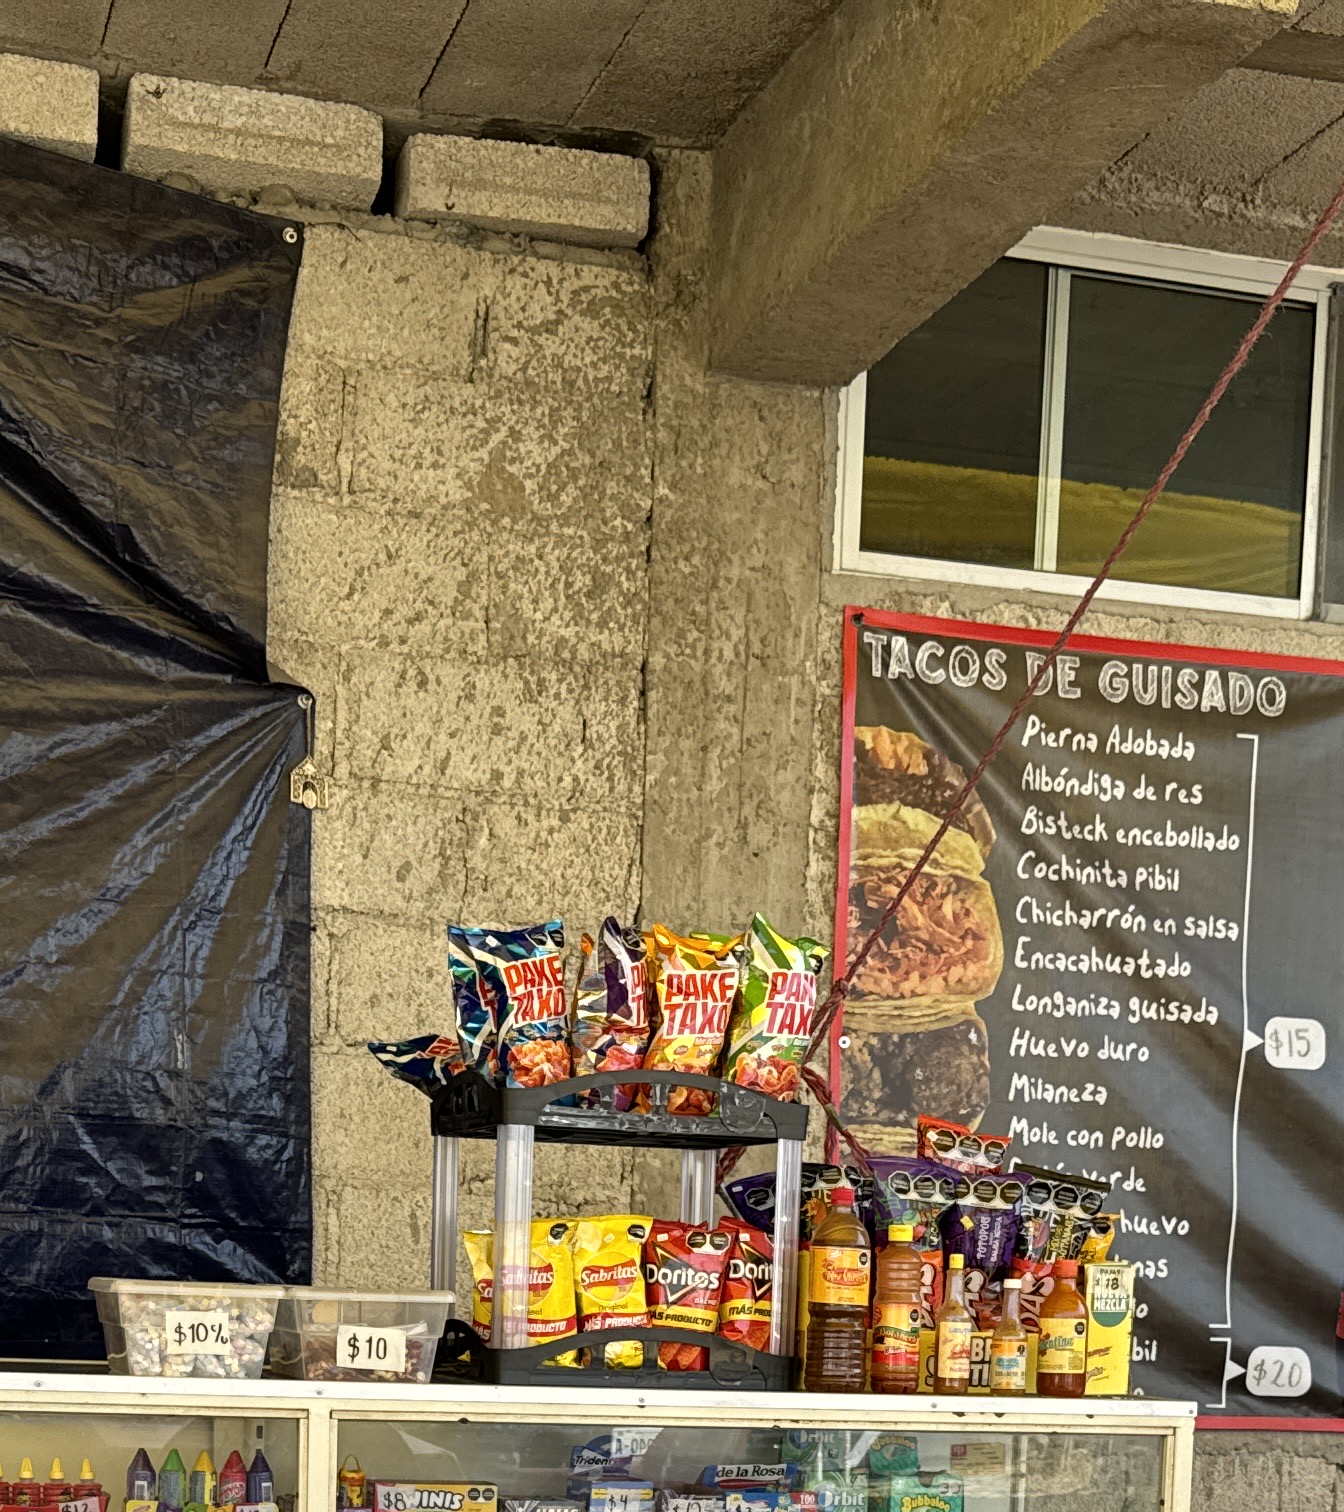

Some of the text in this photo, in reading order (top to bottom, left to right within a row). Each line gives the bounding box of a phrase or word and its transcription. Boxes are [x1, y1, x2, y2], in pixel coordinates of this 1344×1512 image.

[863, 633, 1287, 717] TACOS DE GUISADO
[1021, 715, 1196, 761] Pierna Adobada
[1021, 764, 1203, 805] Albóndiga de res
[1020, 807, 1240, 852] Bisteck encebollado
[1015, 897, 1239, 942] Chicharrón en salsa
[1014, 937, 1192, 979] Encacahuatado
[504, 955, 562, 994] PAKE
[665, 972, 738, 1002] PAKE
[511, 987, 566, 1023] TAXO
[1012, 985, 1219, 1026] Longaniza guisada
[1009, 1029, 1150, 1063] Huevo duro
[1268, 1027, 1311, 1058] $15
[1009, 1073, 1107, 1105] Milaneza
[977, 1216, 990, 1259] TOTOPOS
[580, 1265, 639, 1286] Sabritas
[646, 1265, 719, 1290] Doritos
[1093, 1298, 1127, 1310] MEZCLA
[348, 1335, 387, 1362] $10
[1253, 1361, 1302, 1390] $20
[717, 1465, 785, 1478] de la Rosa
[383, 1493, 405, 1511] $8
[800, 1495, 815, 1504] 100
[901, 1495, 951, 1512] Bubbaloo
